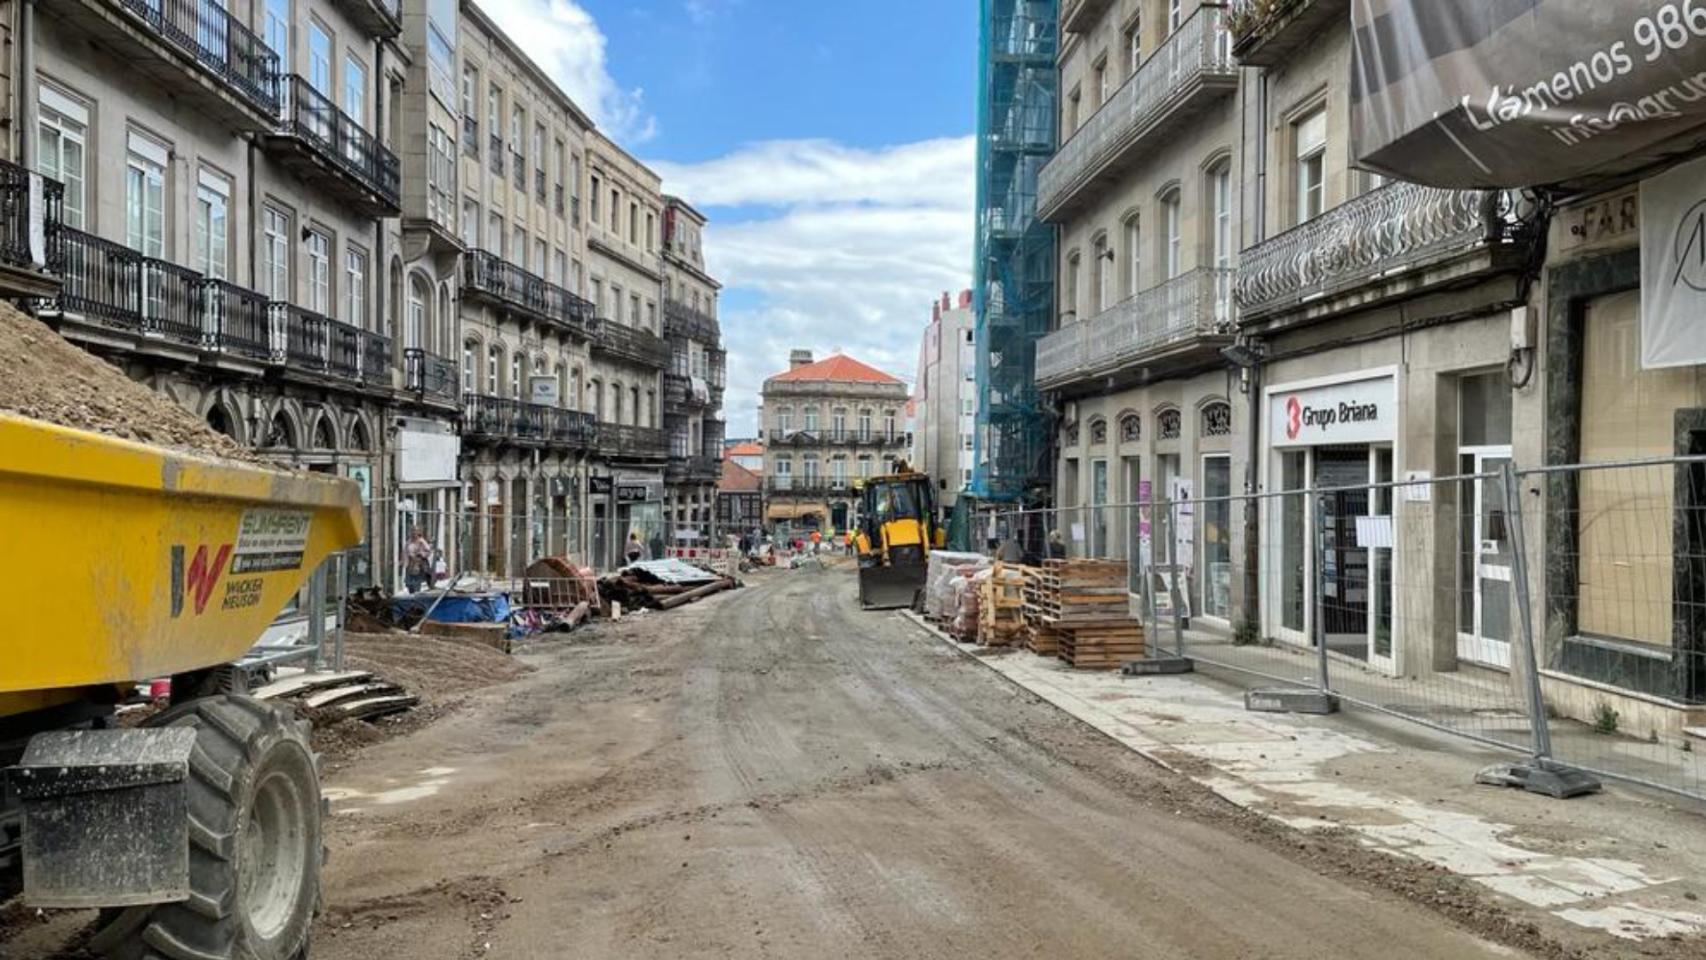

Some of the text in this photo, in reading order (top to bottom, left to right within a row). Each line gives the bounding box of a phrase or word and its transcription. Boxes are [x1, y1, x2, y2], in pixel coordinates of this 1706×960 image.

[1462, 0, 1706, 131] Llámenos 986
[1303, 400, 1377, 431] Grupo Briana
